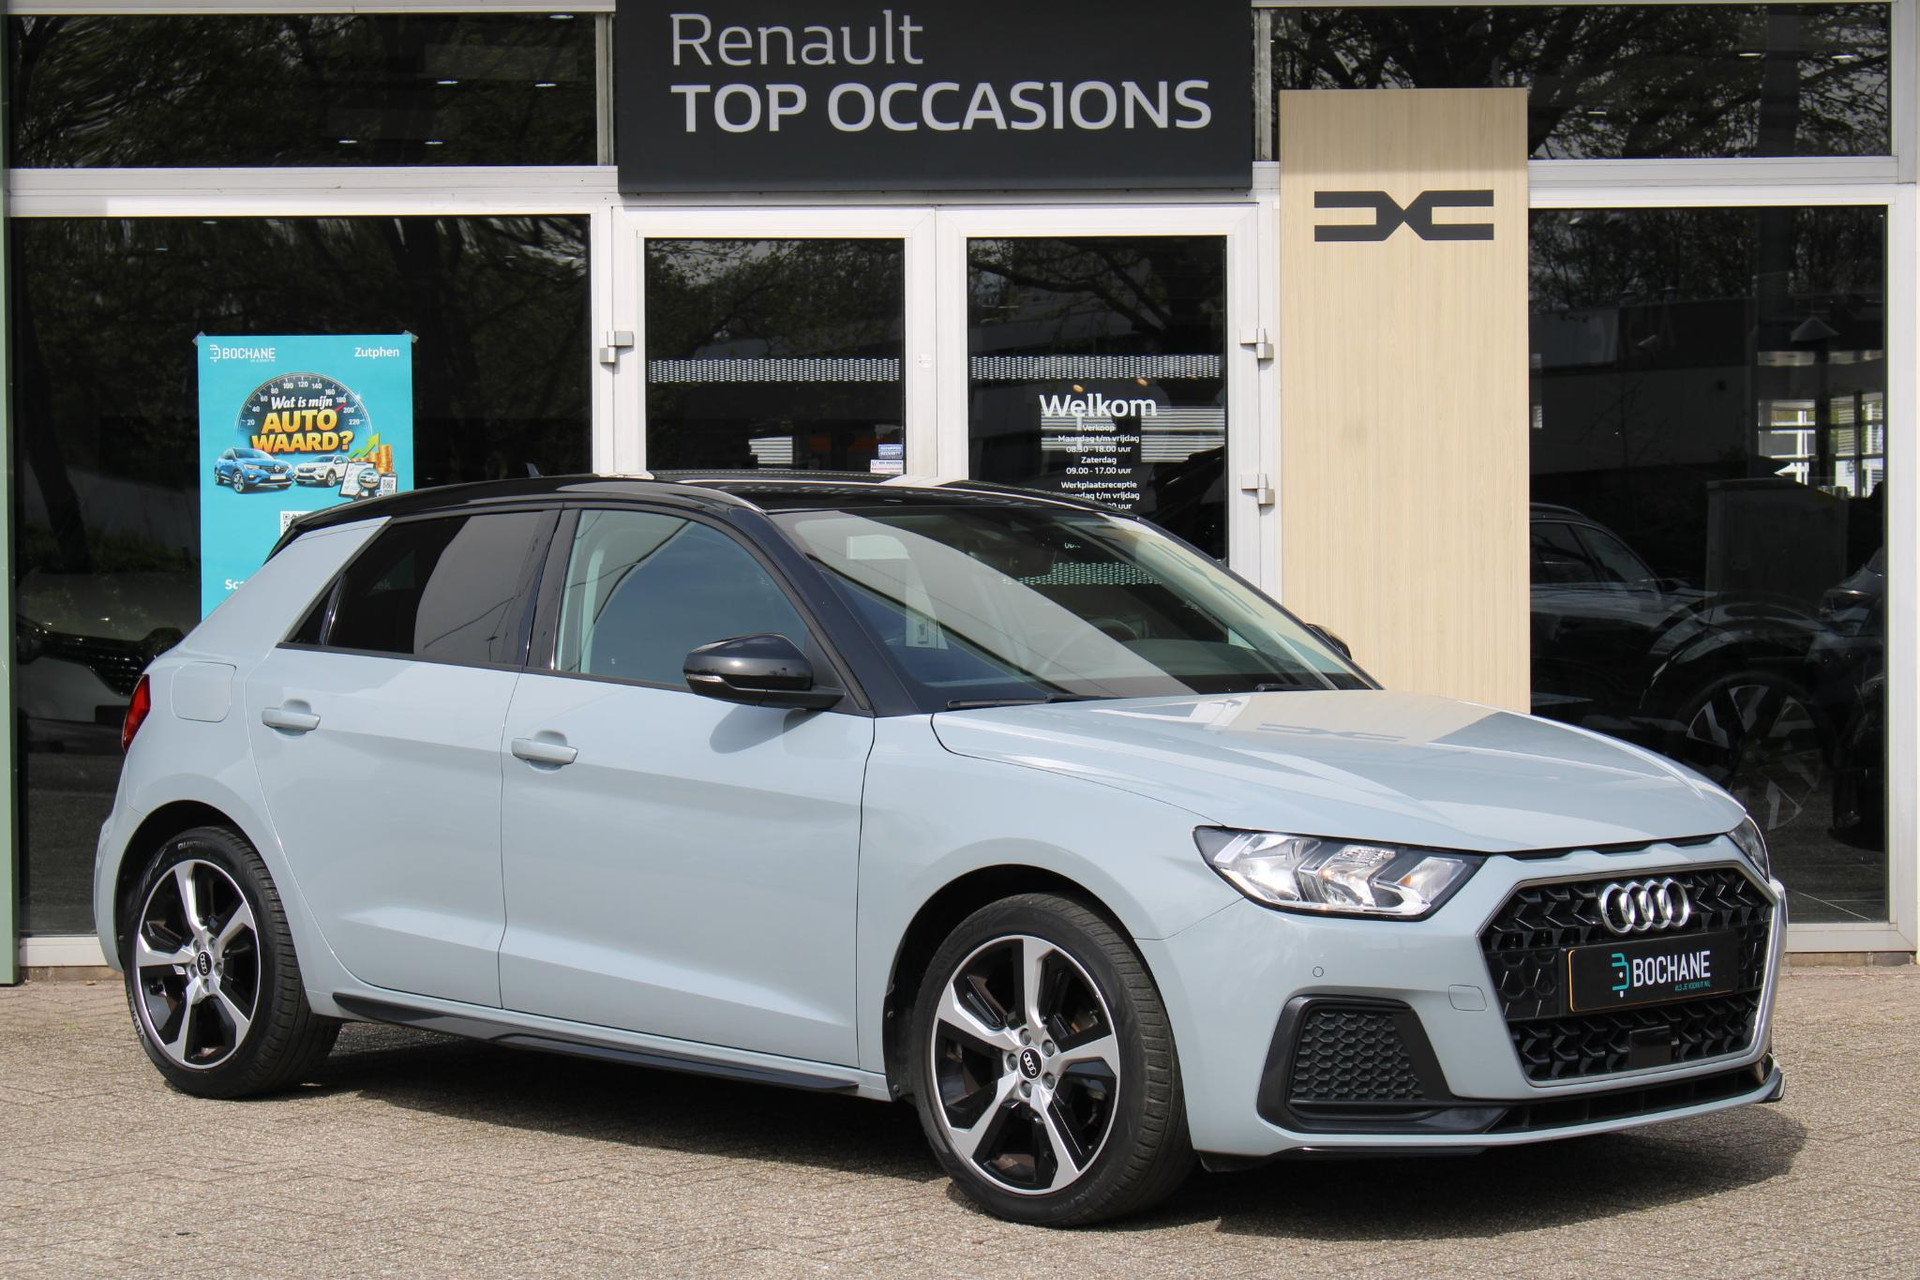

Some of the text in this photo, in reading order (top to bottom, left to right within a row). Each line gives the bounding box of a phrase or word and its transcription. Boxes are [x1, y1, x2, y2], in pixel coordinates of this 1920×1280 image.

[670, 9, 924, 66] Renault
[671, 79, 1212, 133] TOP OCCASIONS
[222, 347, 276, 360] BOCHANE
[354, 346, 400, 359] Zutphen
[271, 395, 333, 410] Wat is mijn
[1039, 393, 1158, 417] Welkom
[262, 410, 337, 434] AUTO
[1082, 424, 1115, 433] Verkoop
[252, 432, 353, 453] WAARD?
[1058, 434, 1140, 443] Maandag t/m vrijdag
[1081, 456, 1117, 465] Zaterdag
[1066, 467, 1089, 475] 09.00
[1094, 467, 1116, 475] 17.00
[1061, 481, 1137, 490] Werkplaatsreceptie
[1096, 492, 1111, 500] t/m
[1112, 491, 1140, 501] vrijdag
[225, 578, 244, 590] Sc
[1633, 950, 1711, 987] BOCHANE
